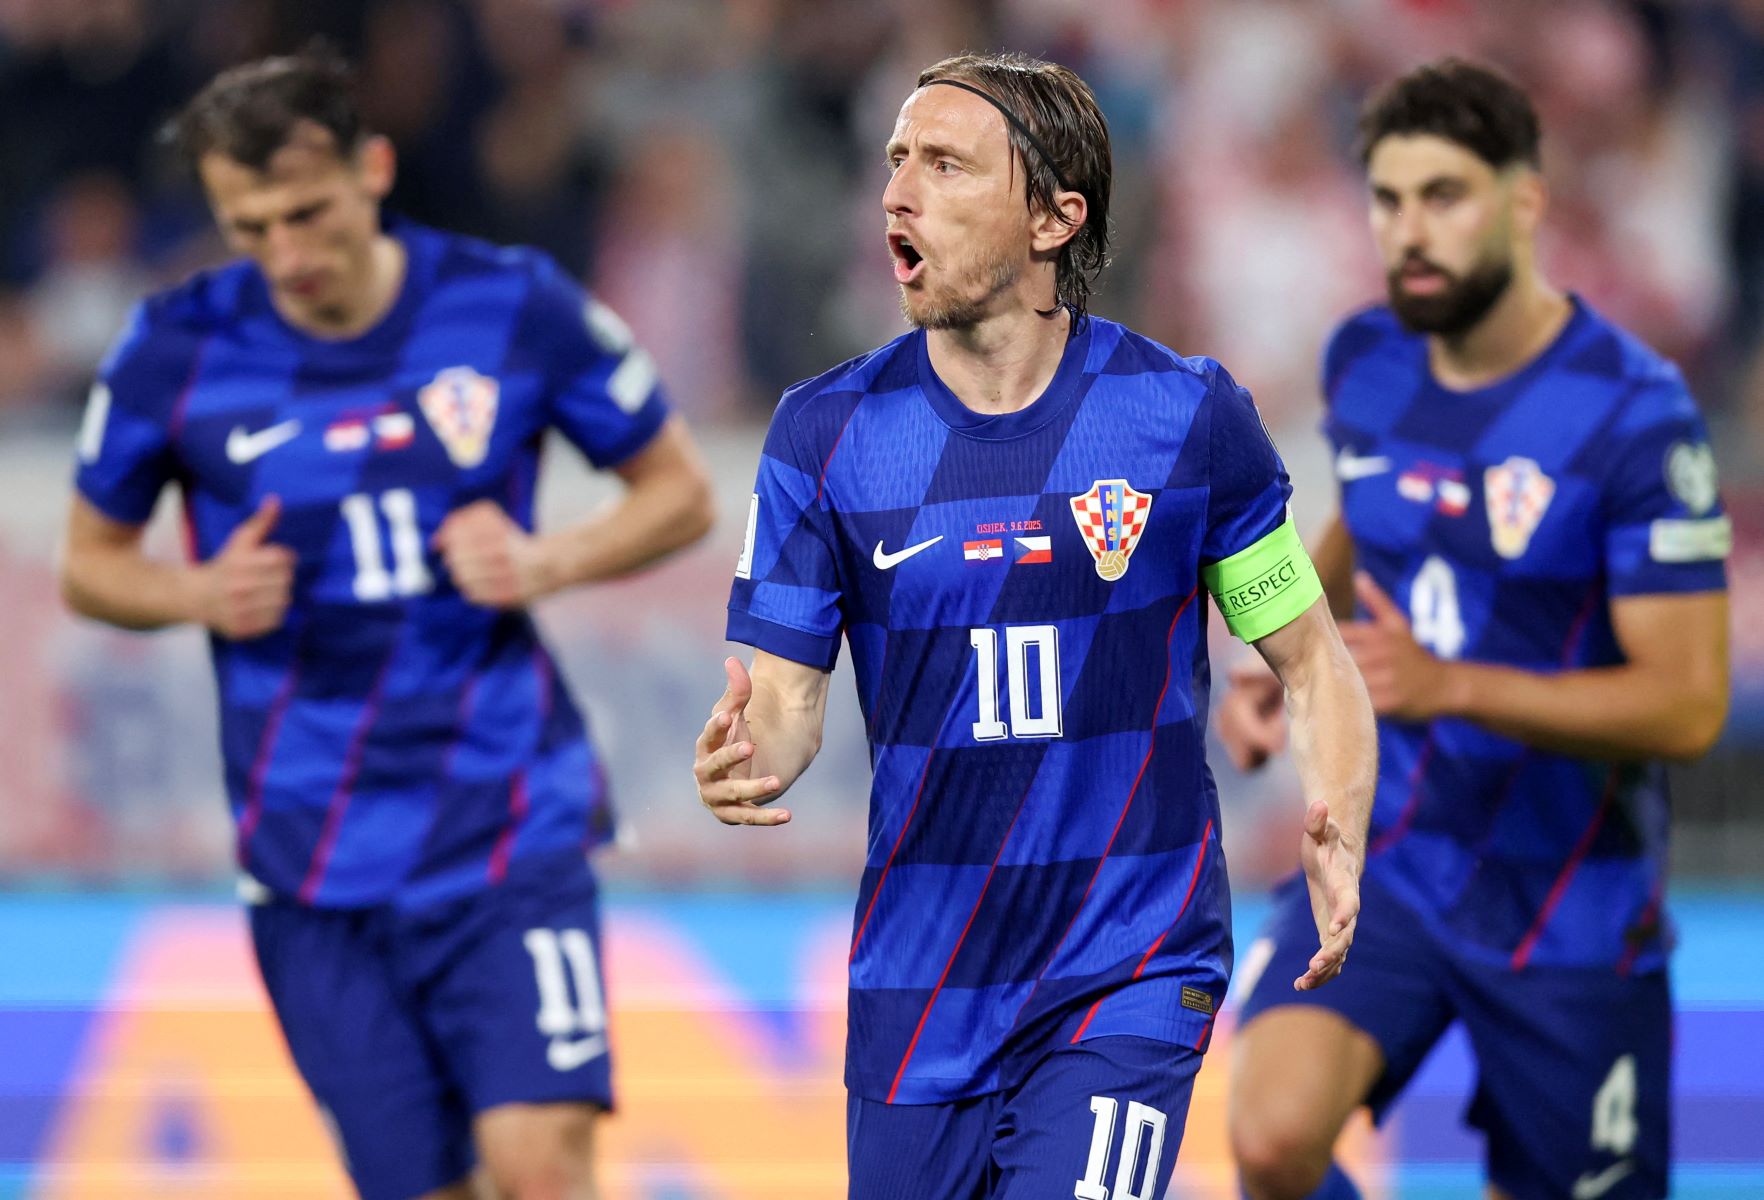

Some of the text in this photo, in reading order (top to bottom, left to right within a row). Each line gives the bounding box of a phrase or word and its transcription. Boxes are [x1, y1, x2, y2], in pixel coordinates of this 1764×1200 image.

[340, 489, 434, 602] 11
[1105, 490, 1119, 542] HNS
[1228, 560, 1296, 611] RESPECT
[1410, 555, 1466, 660] 4
[970, 625, 1064, 742] 10
[523, 927, 607, 1036] 11
[1074, 1095, 1168, 1200] 10
[1591, 1053, 1639, 1155] 4
